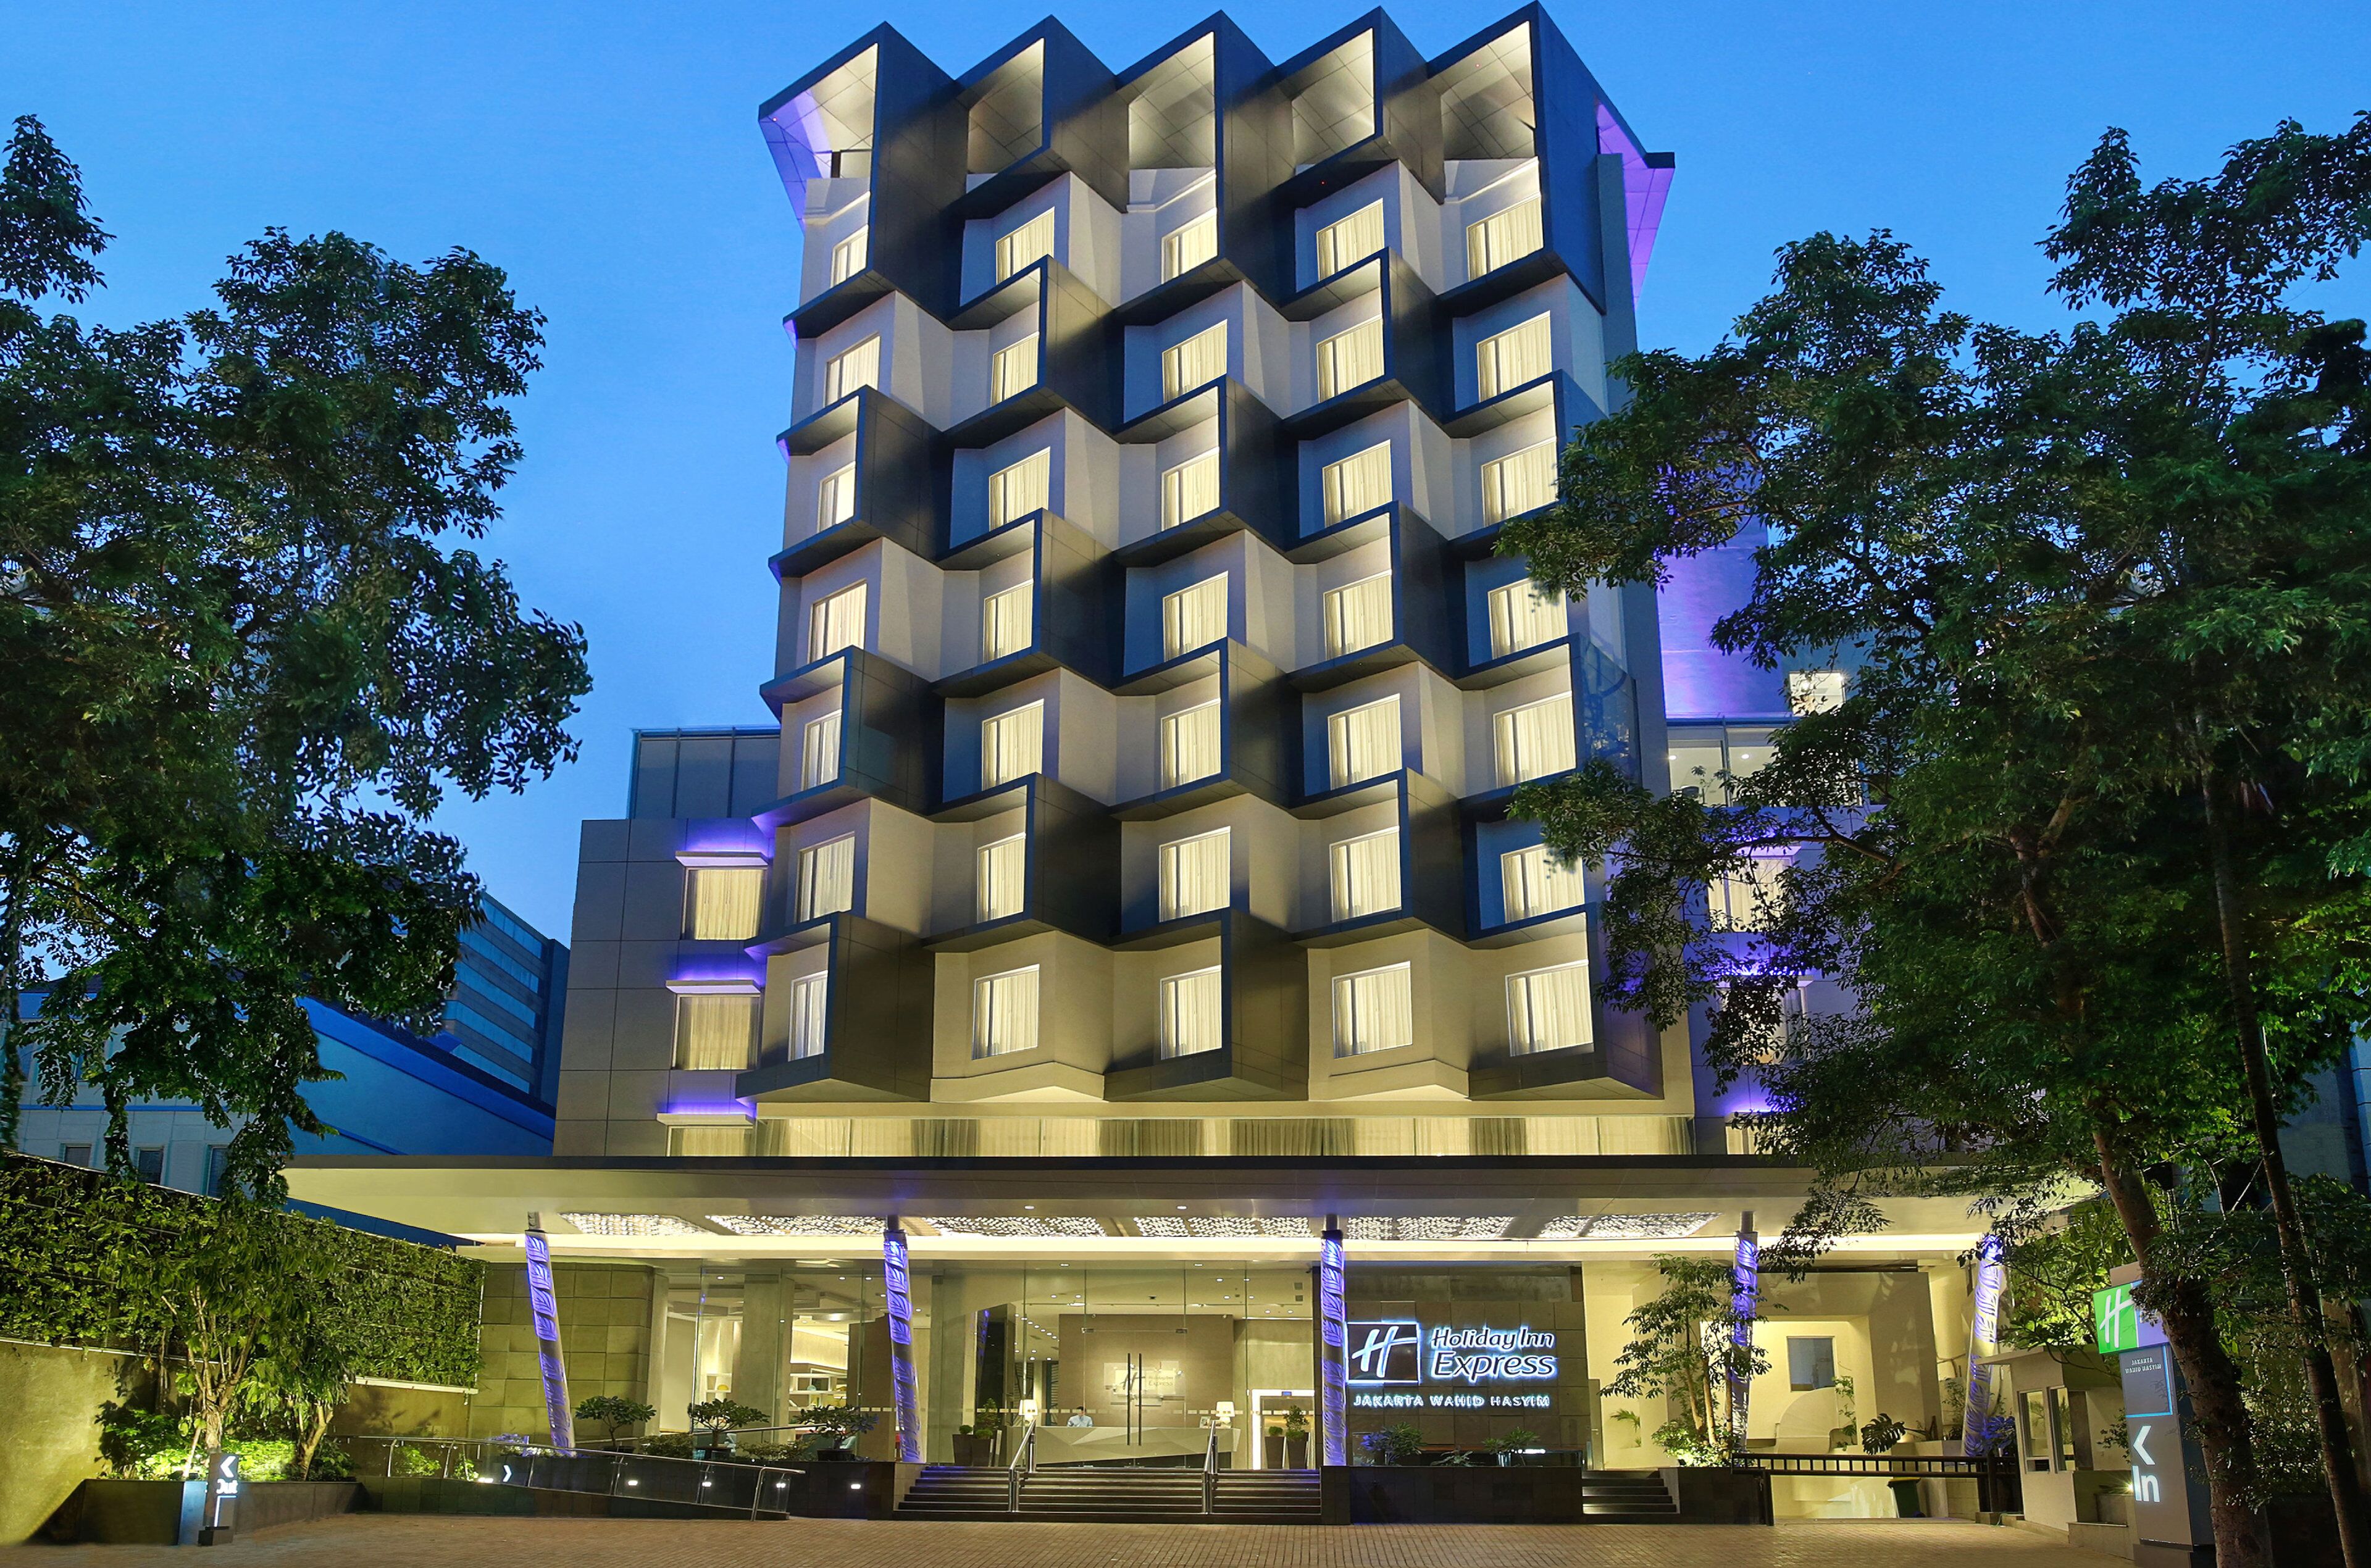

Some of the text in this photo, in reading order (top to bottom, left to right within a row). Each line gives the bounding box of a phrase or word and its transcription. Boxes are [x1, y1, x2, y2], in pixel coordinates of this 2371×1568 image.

[1431, 1327, 1555, 1351] Holiday Inn
[1432, 1351, 1555, 1382] Express
[1353, 1395, 1550, 1407] JAKARTA WAHID HASYIM
[2132, 1466, 2160, 1502] In
